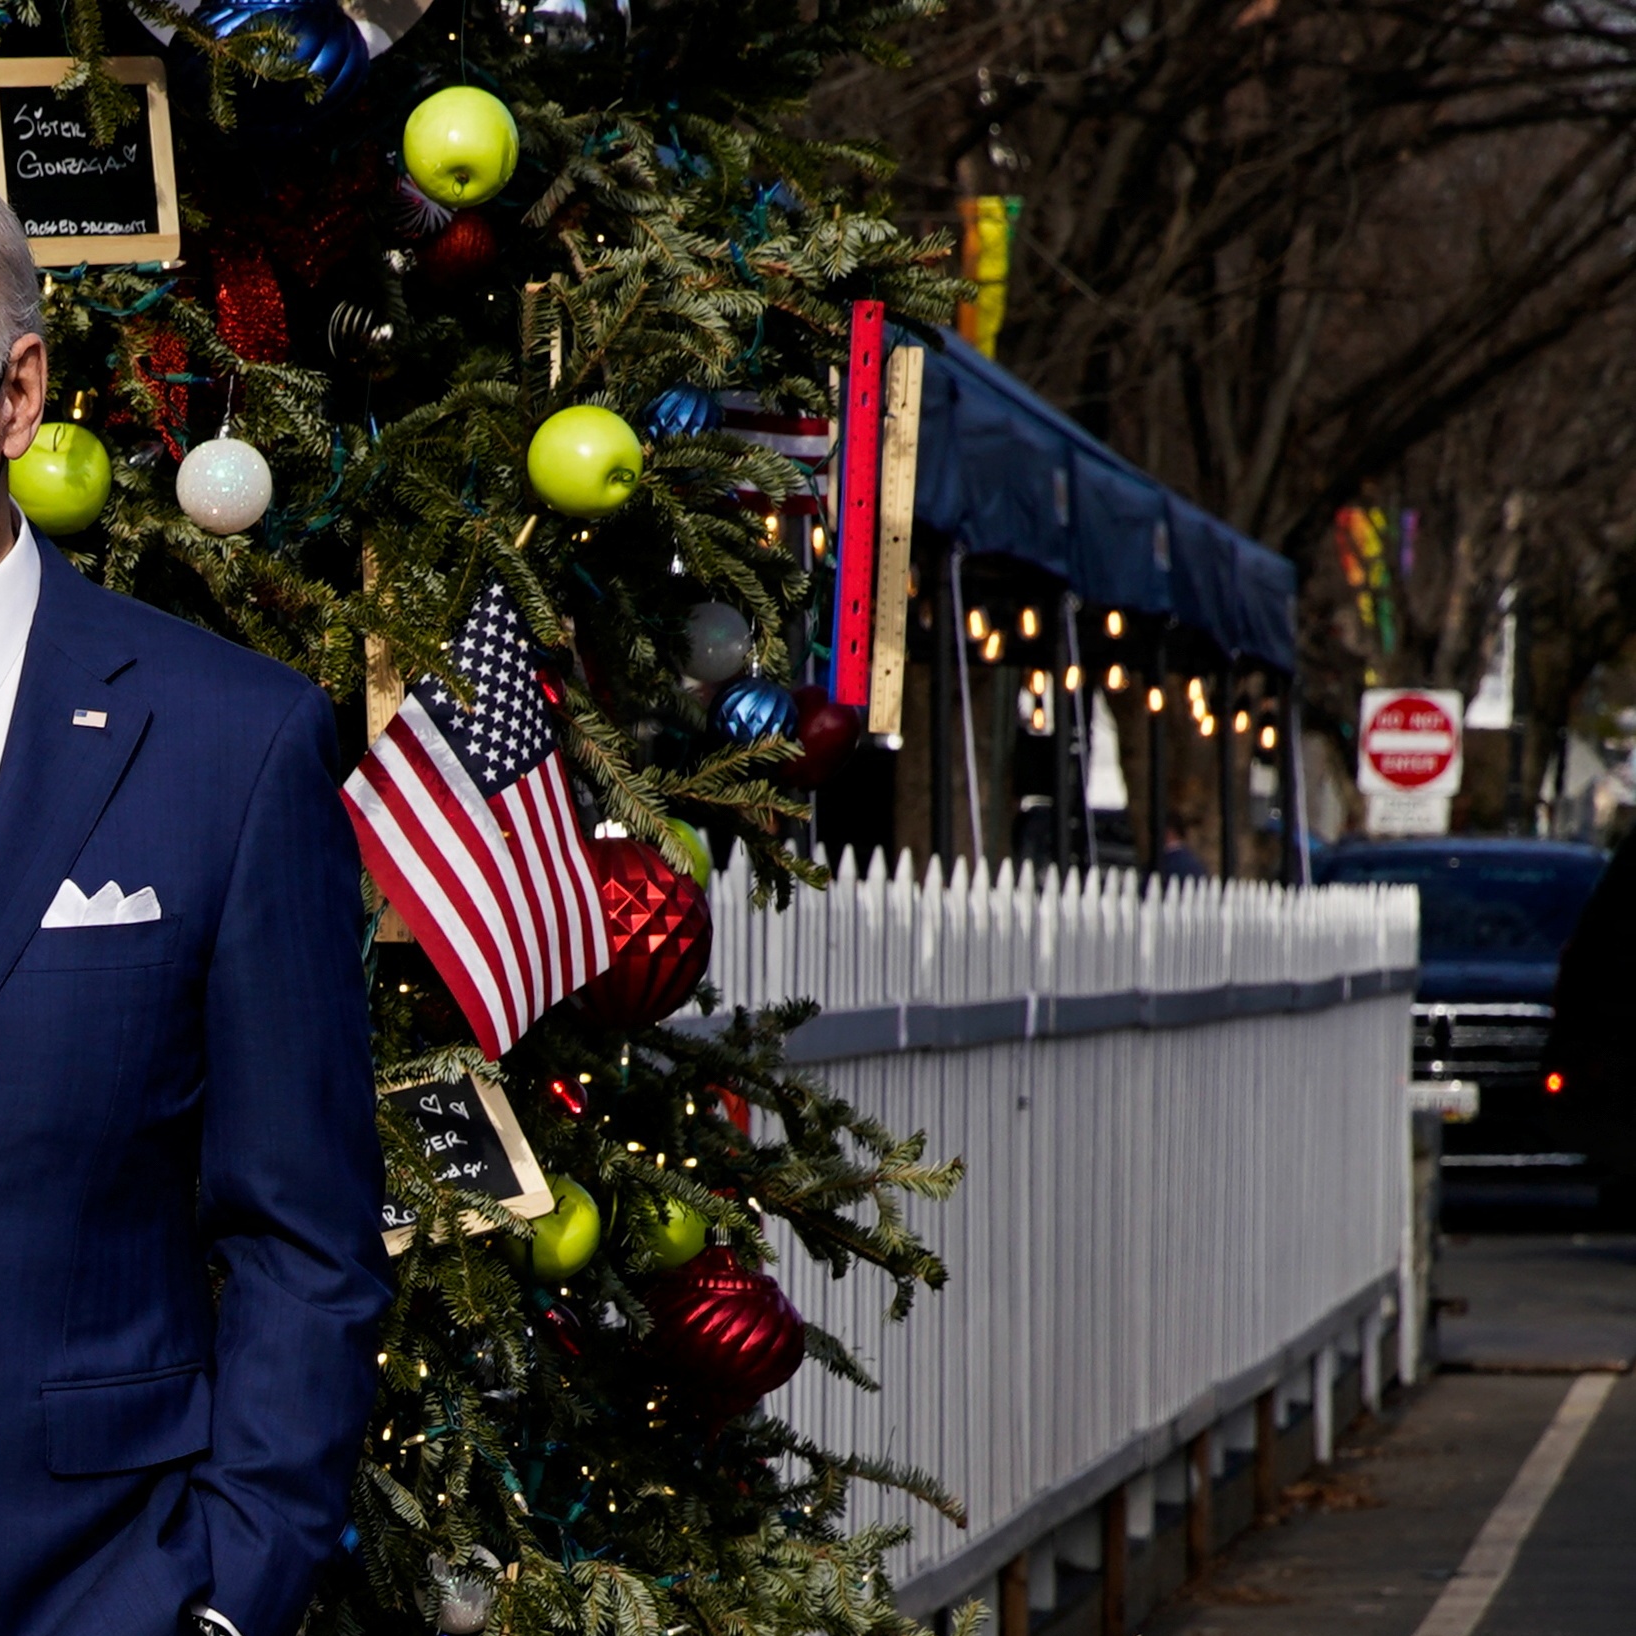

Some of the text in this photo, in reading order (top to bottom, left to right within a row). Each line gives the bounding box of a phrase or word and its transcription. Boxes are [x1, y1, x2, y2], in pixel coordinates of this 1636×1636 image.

[1376, 708, 1446, 730] DO NOT
[1380, 755, 1439, 775] ENTER
